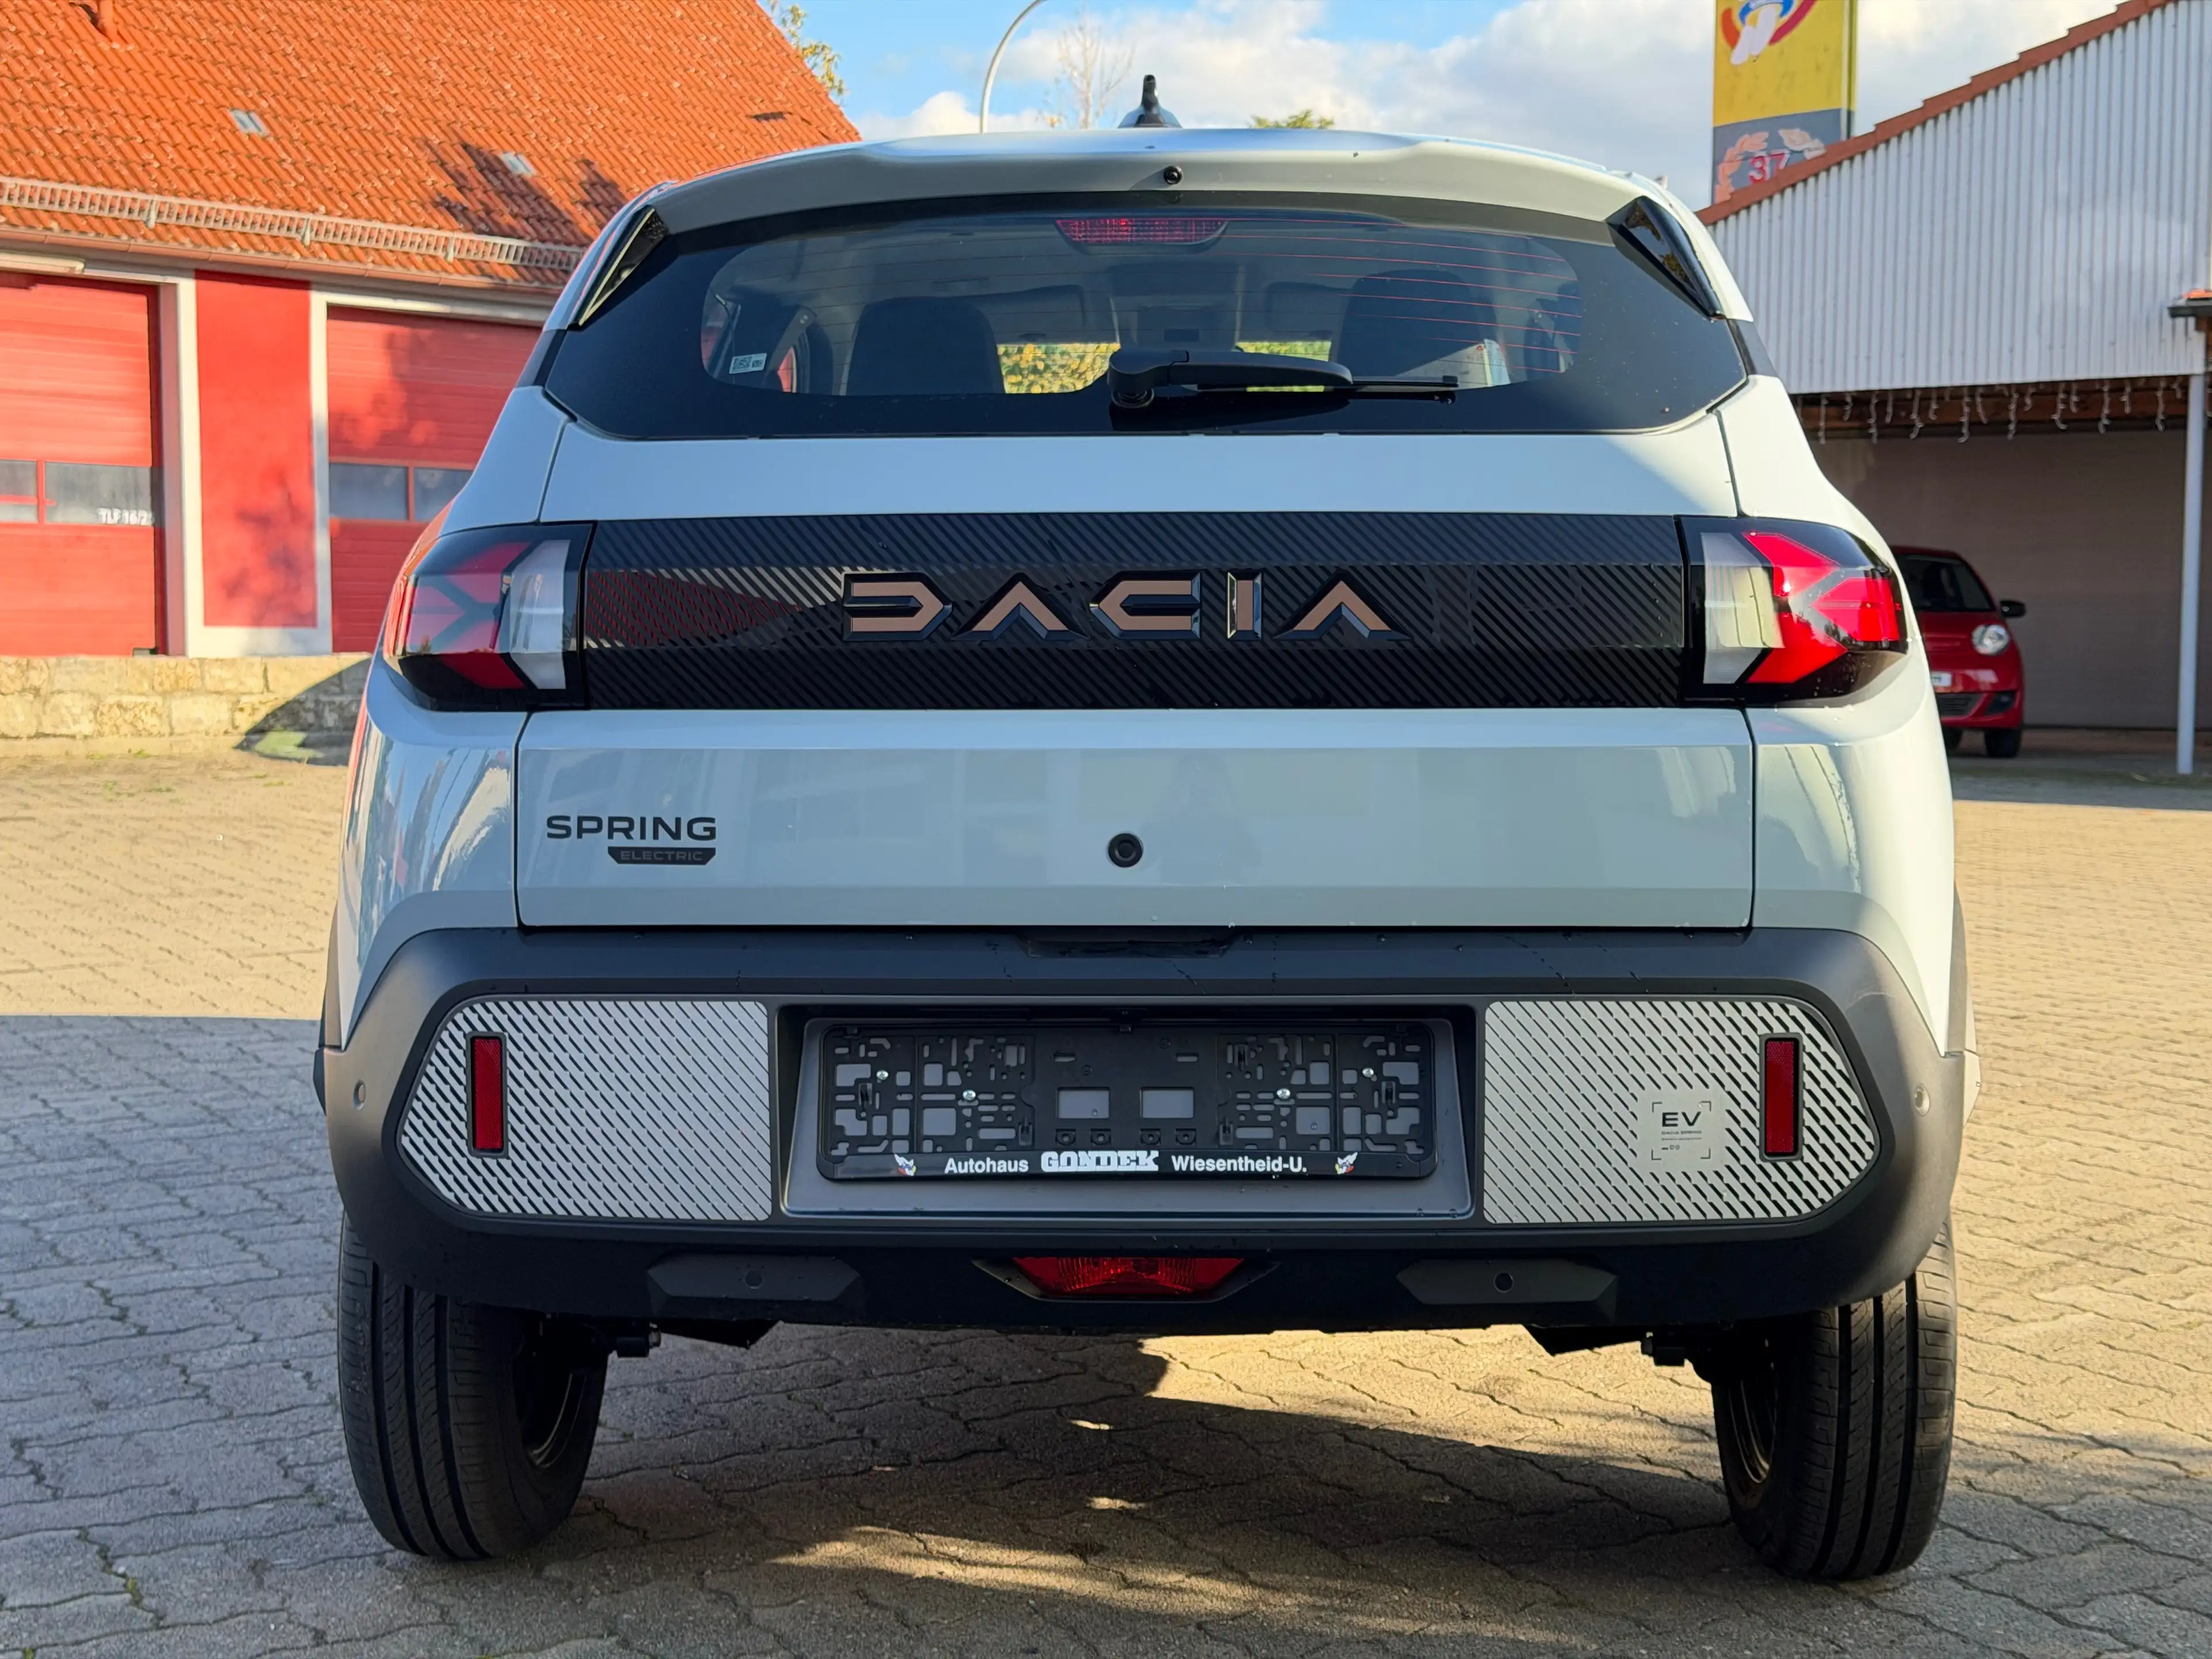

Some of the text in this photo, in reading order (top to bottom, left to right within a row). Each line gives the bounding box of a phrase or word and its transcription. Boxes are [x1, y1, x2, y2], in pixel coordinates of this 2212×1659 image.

[843, 574, 1408, 641] DACIA
[547, 815, 717, 841] SPRING
[620, 850, 703, 861] ELECTRIC
[1662, 1111, 1701, 1127] EV
[944, 1150, 1308, 1174] Autohaus GONDEK Wiesentheid-U.
